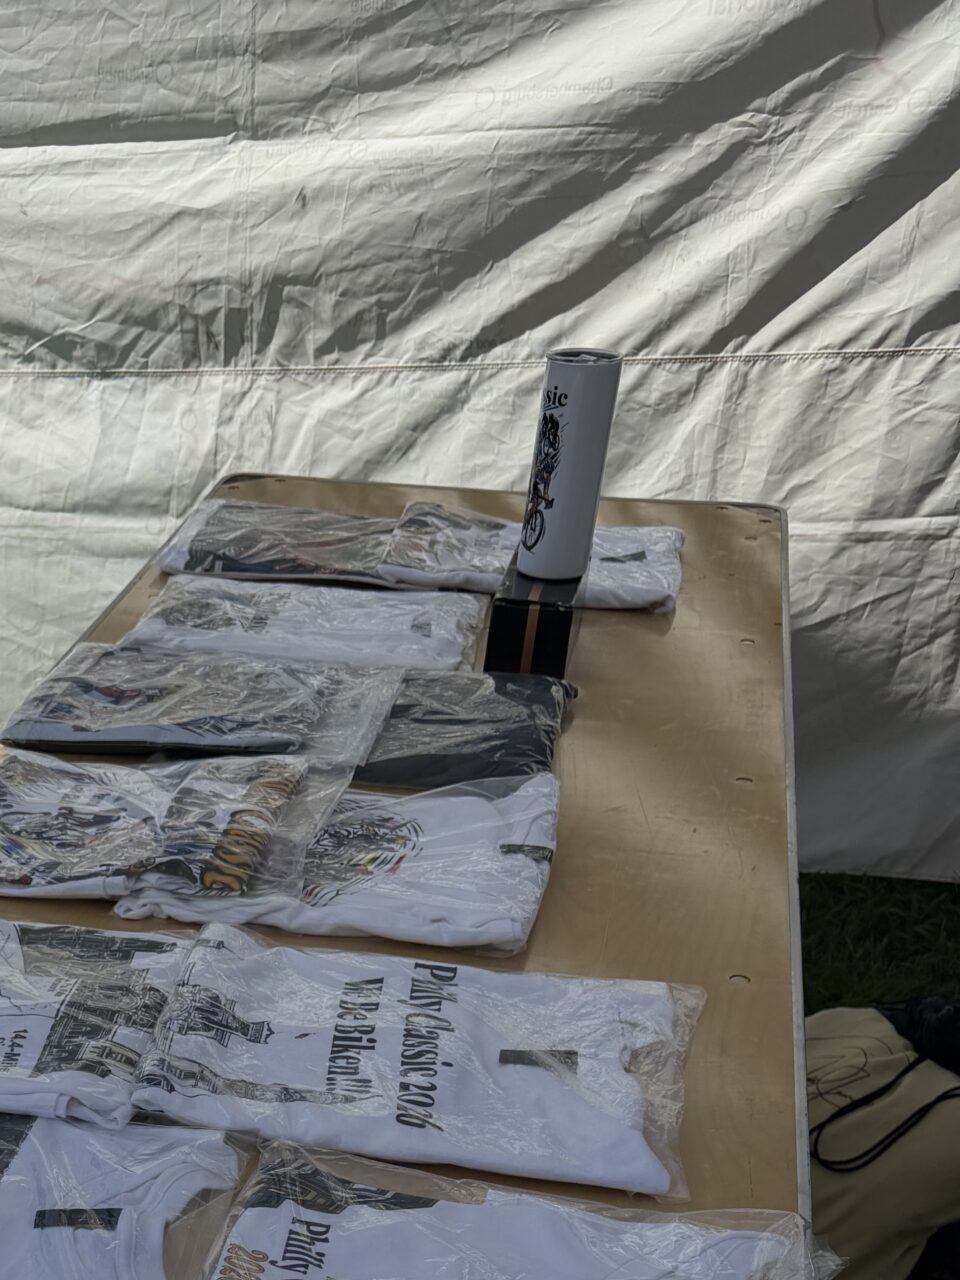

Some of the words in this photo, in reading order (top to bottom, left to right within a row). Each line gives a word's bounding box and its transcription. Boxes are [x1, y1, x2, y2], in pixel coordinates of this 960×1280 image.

[337, 1000, 380, 1021] Be
[342, 977, 385, 999] We
[397, 961, 459, 1012] Philly
[400, 1013, 455, 1078] Classic
[395, 1081, 445, 1132] 2026
[269, 1217, 332, 1275] Philly
